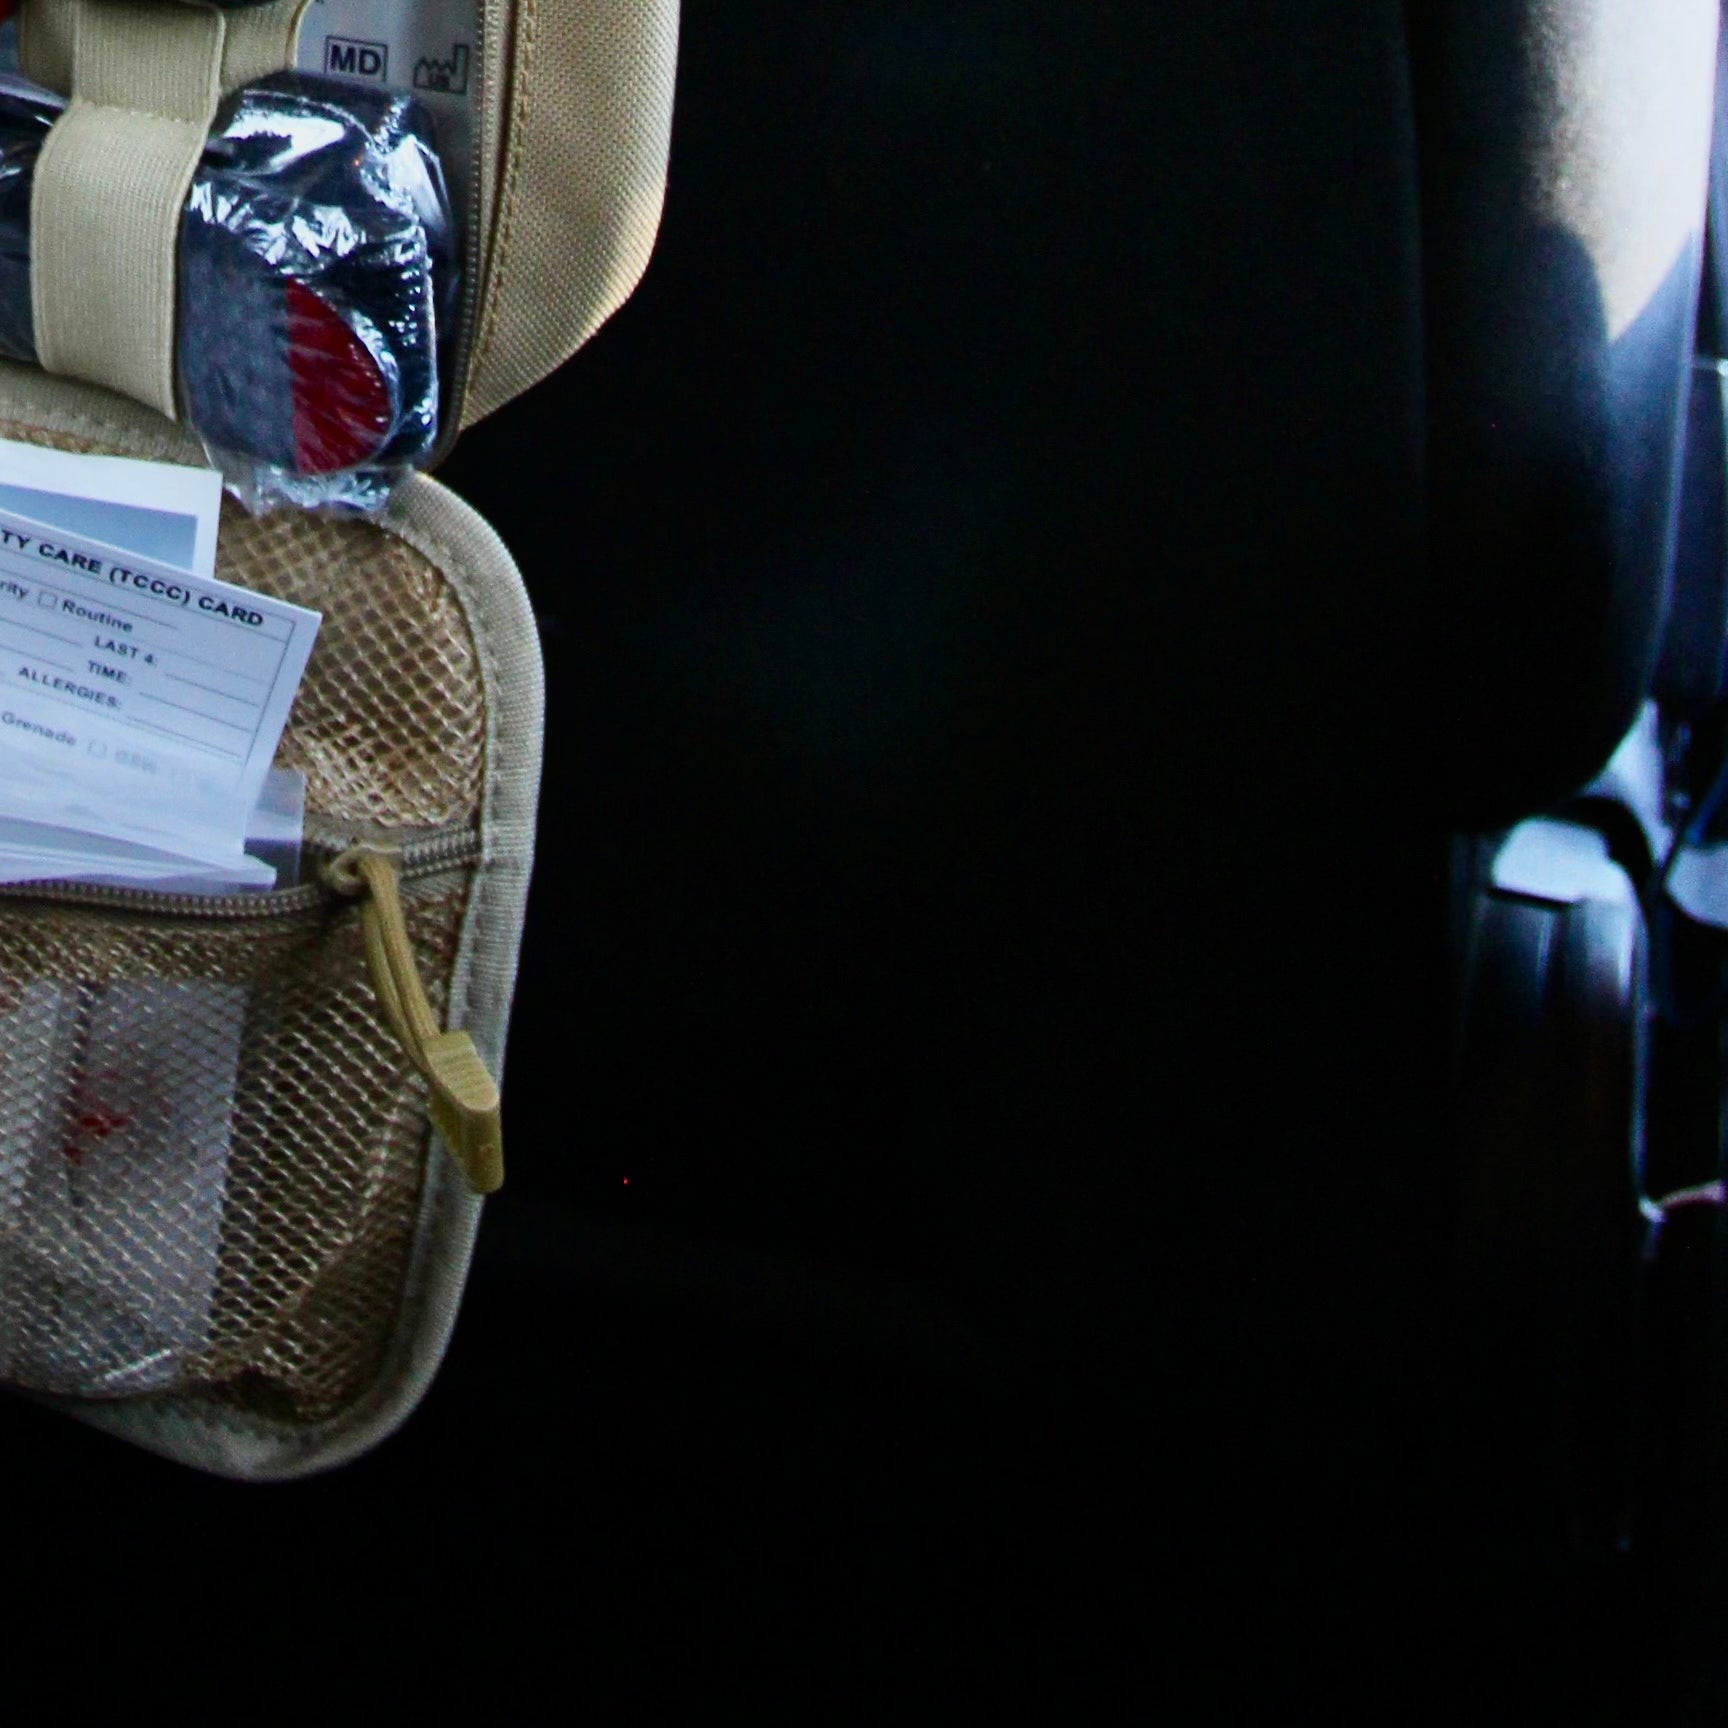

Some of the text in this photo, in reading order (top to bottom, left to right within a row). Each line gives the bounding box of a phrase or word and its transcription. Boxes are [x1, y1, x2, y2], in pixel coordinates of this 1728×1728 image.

[330, 45, 382, 75] MD
[38, 543, 102, 575] CARE
[109, 567, 191, 607] (TCCC)
[198, 596, 264, 626] CARD
[62, 599, 133, 633] Routine
[94, 634, 139, 660] LAST
[0, 710, 77, 747] Grenade
